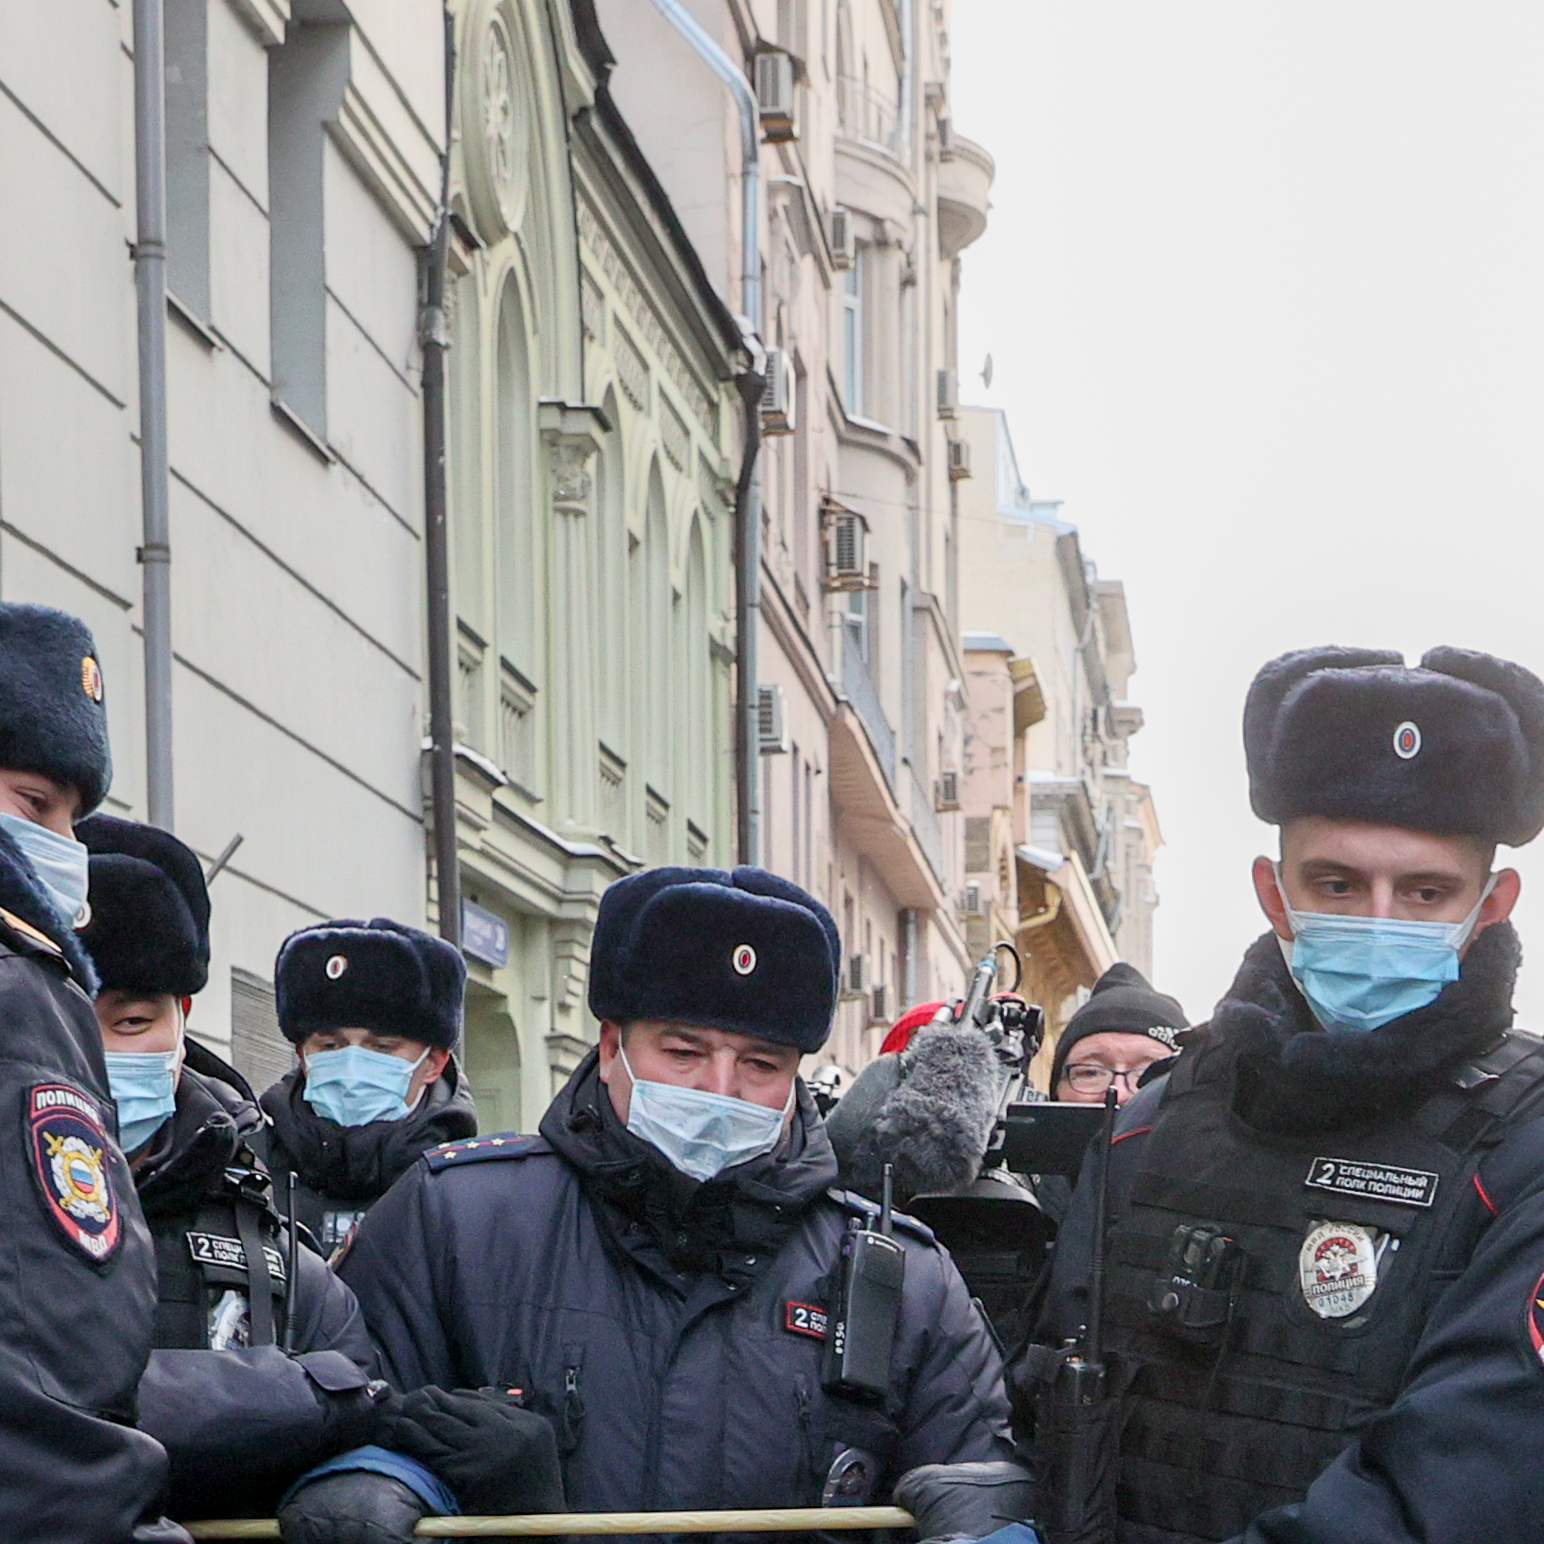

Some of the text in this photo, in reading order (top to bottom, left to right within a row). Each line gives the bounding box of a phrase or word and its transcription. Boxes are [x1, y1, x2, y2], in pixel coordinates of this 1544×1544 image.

[36, 1089, 101, 1127] ПОЛИЦИЯ
[1315, 1163, 1429, 1188] 2 СПЕЦИАЛЬНЫЙ
[1335, 1176, 1424, 1199] ПОЛК ПОЛИЦИИ
[197, 1237, 213, 1258] 2
[1312, 1276, 1364, 1295] ПОЛИЦИЯ
[794, 1307, 809, 1329] 2
